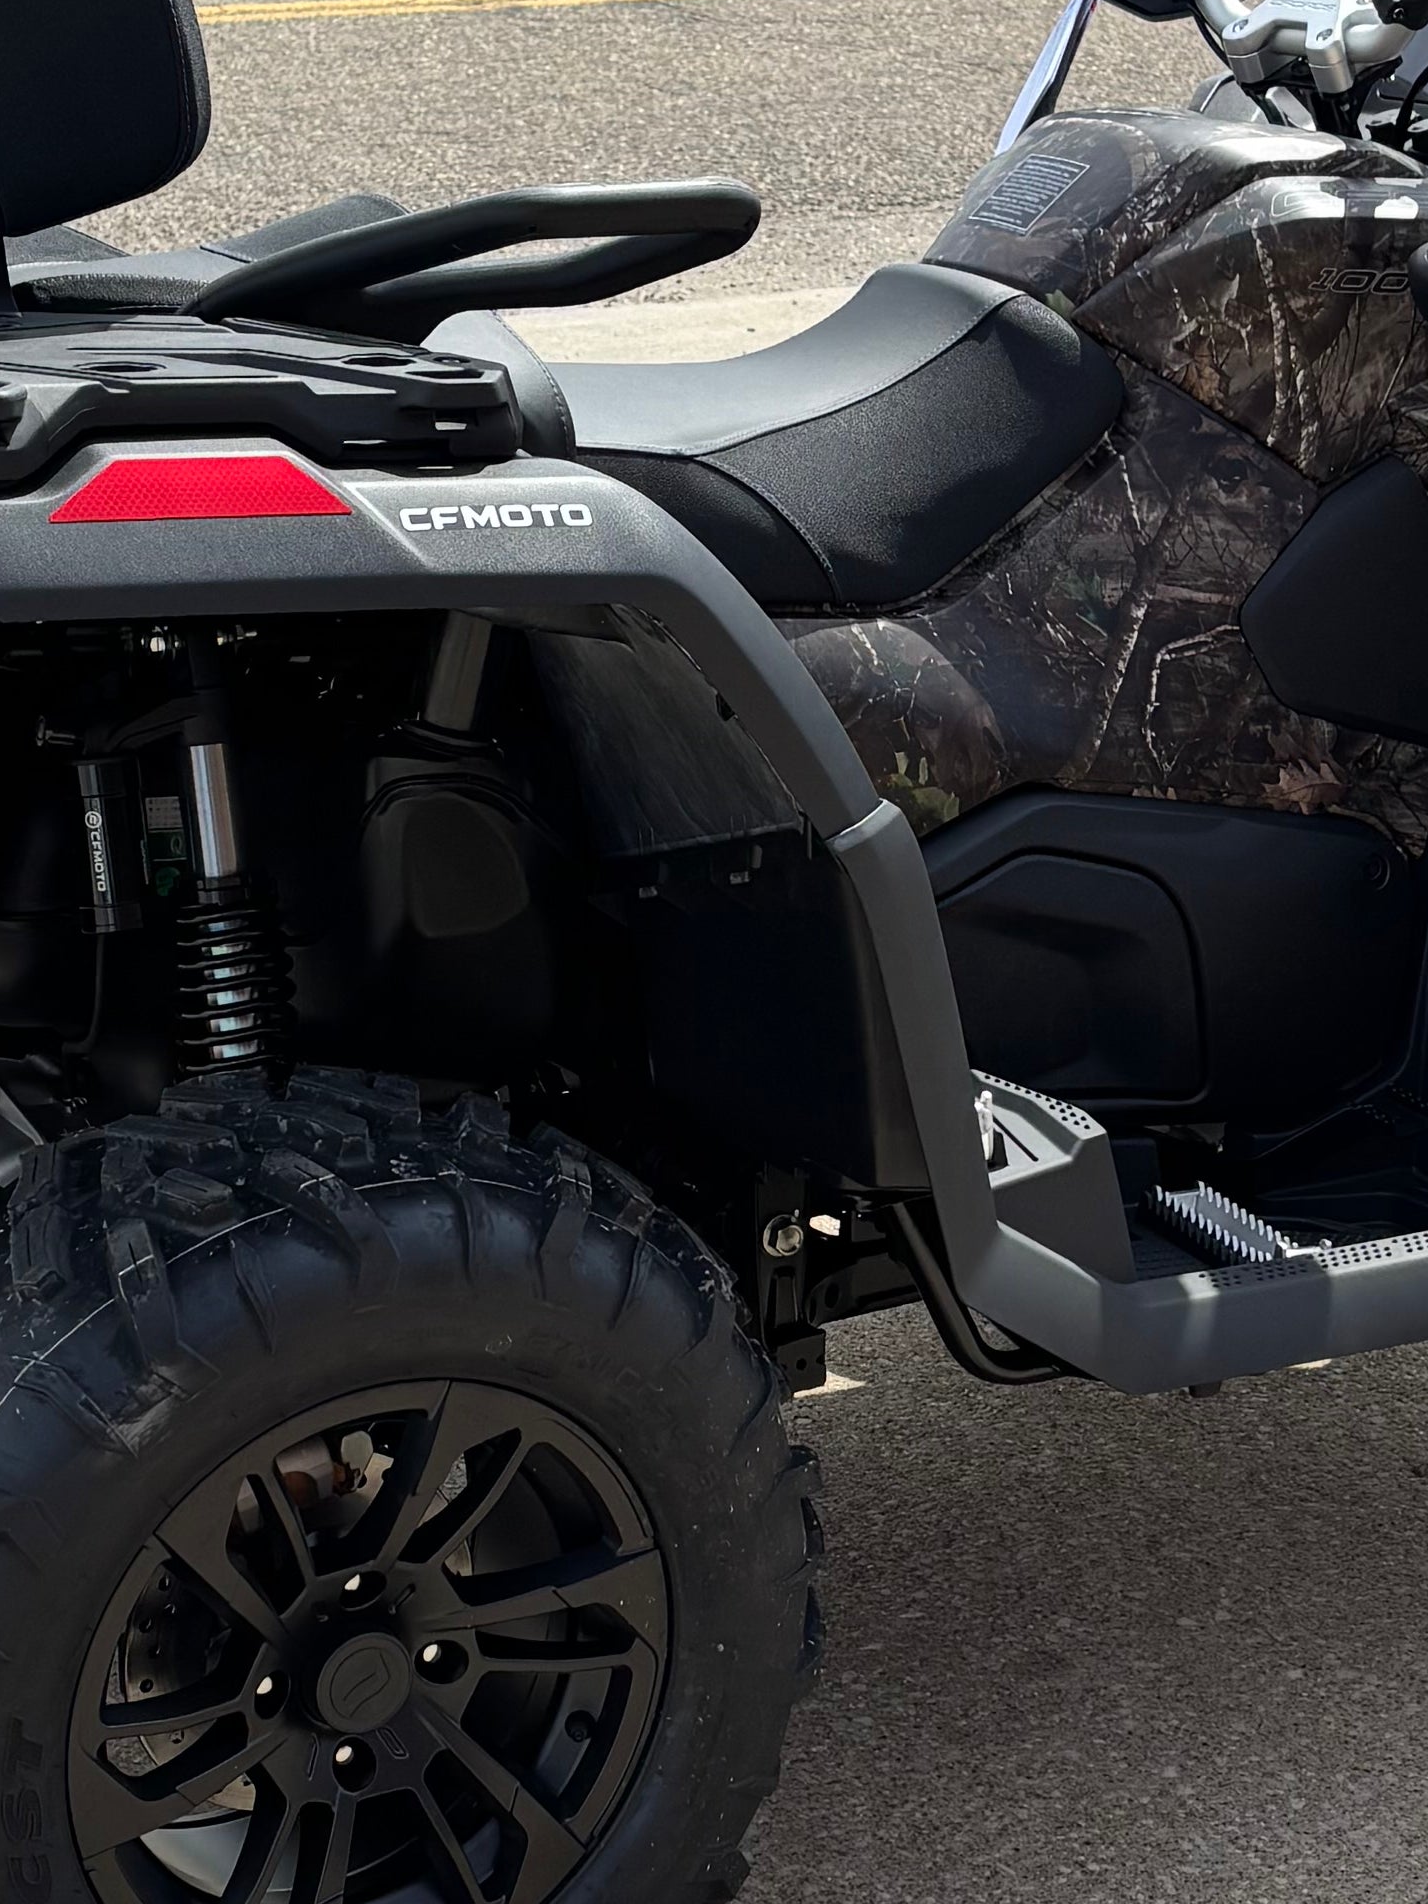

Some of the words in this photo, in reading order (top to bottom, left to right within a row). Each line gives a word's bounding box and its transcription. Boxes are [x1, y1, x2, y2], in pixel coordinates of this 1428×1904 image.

[1308, 267, 1410, 294] 100
[399, 503, 593, 532] CFMOTO
[90, 830, 107, 892] CFMOTO
